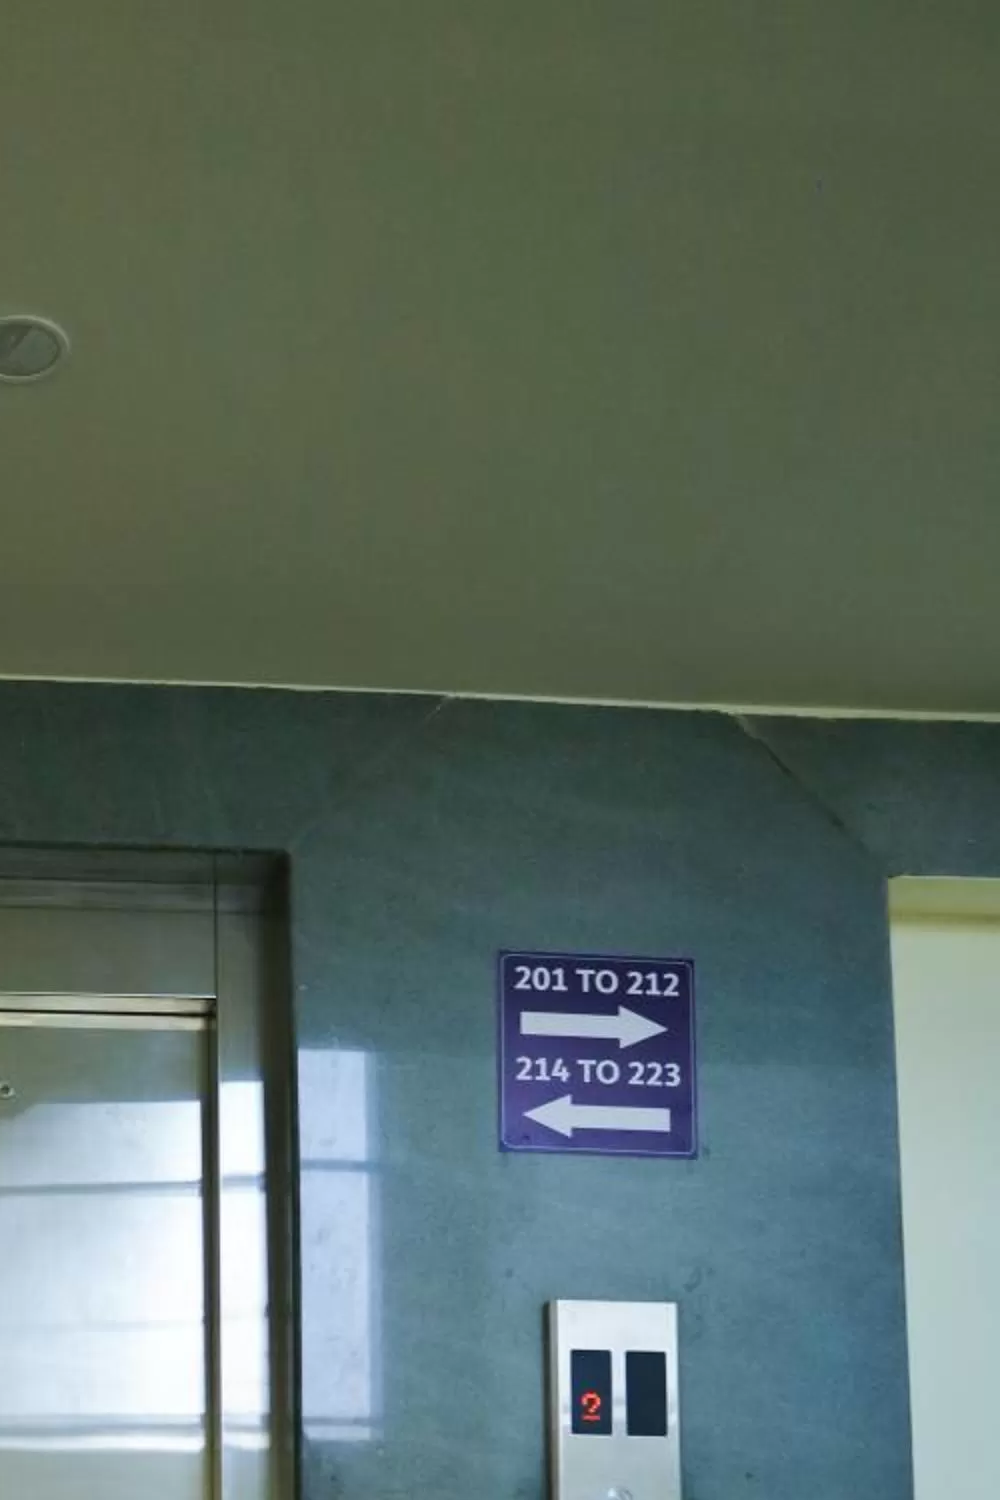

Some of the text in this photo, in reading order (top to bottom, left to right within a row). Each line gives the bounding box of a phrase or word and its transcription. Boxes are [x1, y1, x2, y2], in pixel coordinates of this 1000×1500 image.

[514, 966, 680, 997] 201 TO 212
[515, 1057, 681, 1087] 214 TO 223
